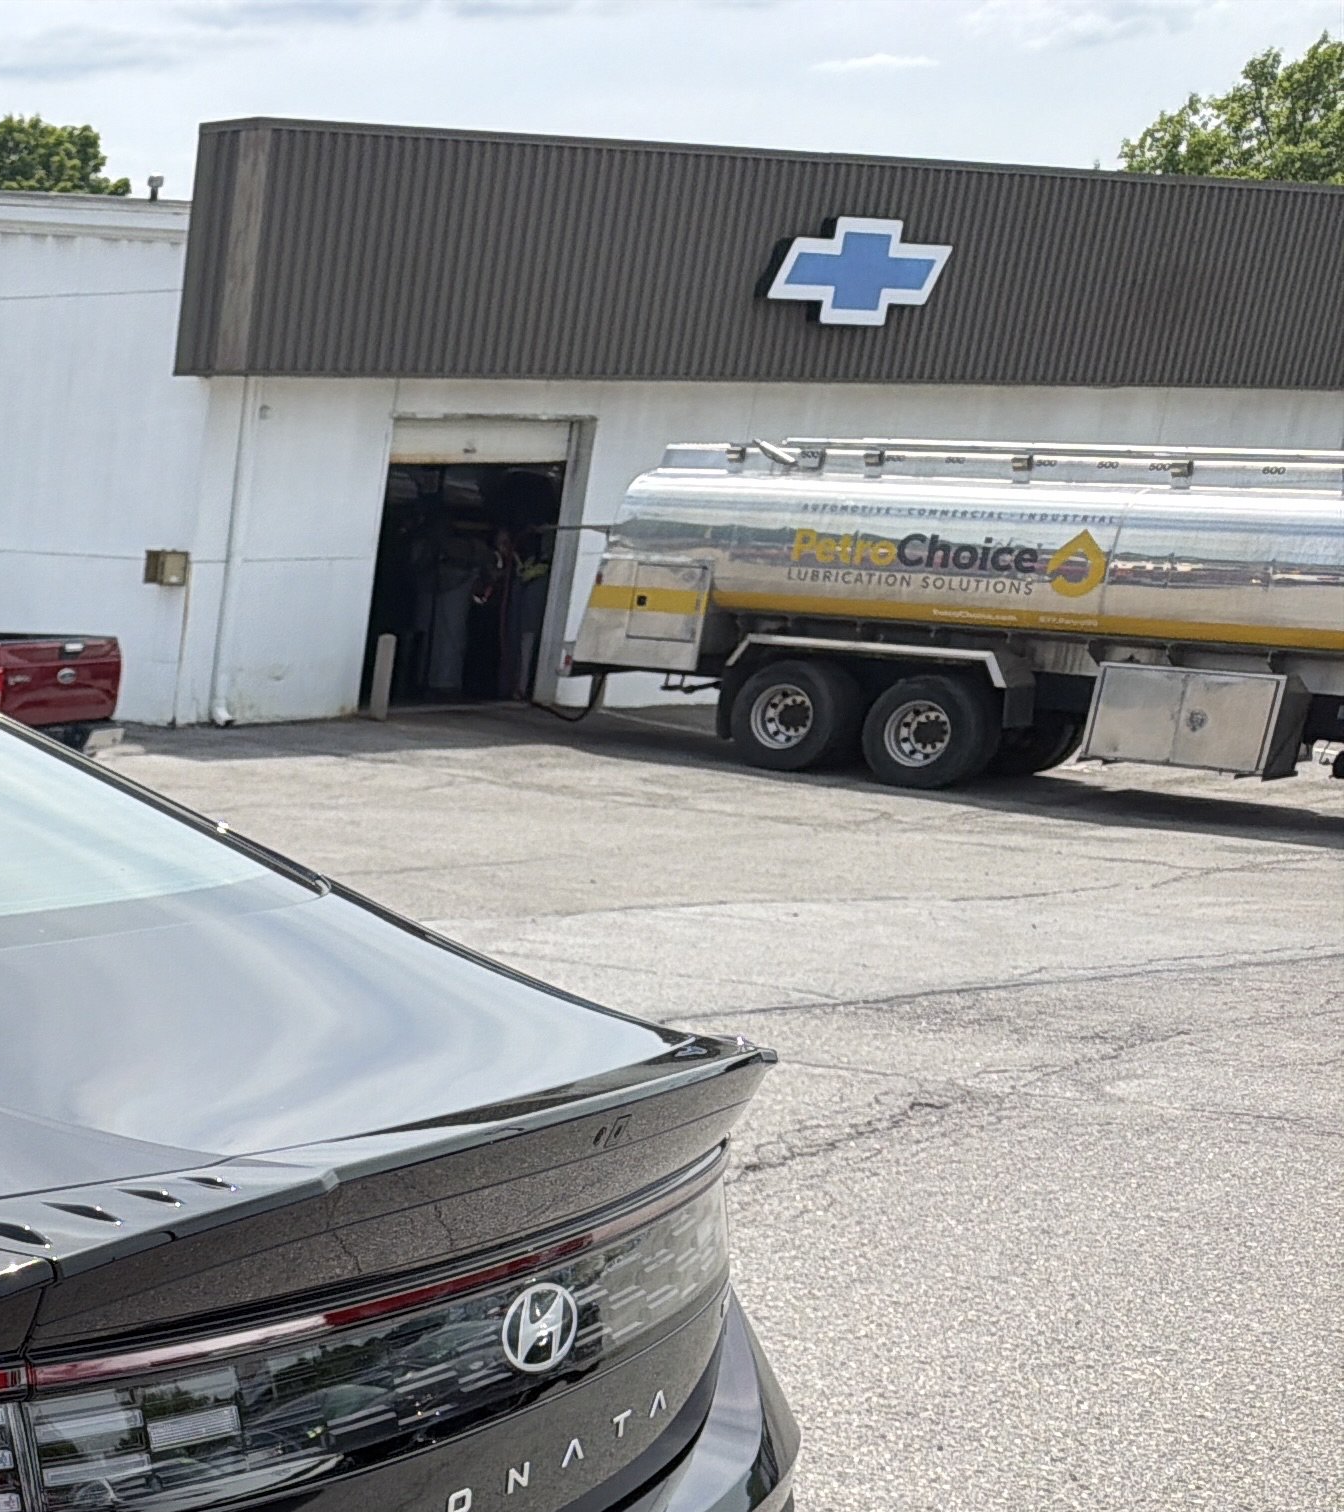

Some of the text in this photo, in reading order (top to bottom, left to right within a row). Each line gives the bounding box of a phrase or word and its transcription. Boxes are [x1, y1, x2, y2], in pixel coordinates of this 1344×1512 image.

[1036, 459, 1057, 467] 500
[1097, 461, 1119, 469] 500
[1148, 463, 1171, 471] 500
[1262, 466, 1286, 475] 600
[801, 503, 1114, 525] AUTOMOTIVE COMMERCIAL INDUSTRIAL
[790, 528, 1039, 574] PetroChoice
[787, 567, 1034, 596] LUBRICATION SOLUTIONS
